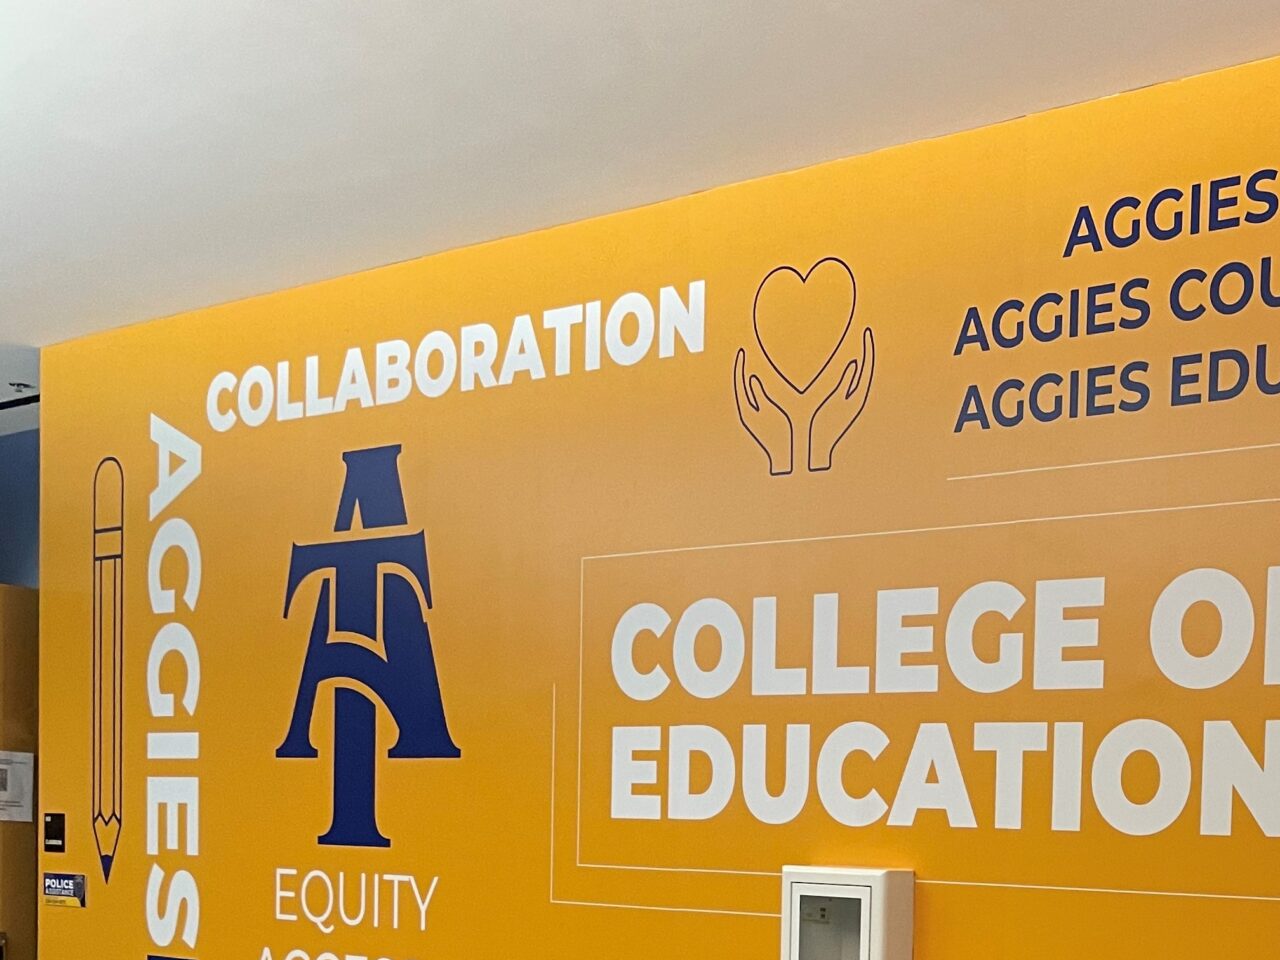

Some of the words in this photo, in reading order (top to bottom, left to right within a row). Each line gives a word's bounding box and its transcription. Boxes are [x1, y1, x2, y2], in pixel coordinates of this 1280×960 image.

[1063, 169, 1278, 257] AGGIES
[954, 278, 1150, 355] AGGIES
[205, 279, 706, 433] COLLABORATION
[954, 361, 1150, 432] AGGIES
[610, 576, 1106, 701] COLLEGE
[45, 878, 74, 889] POLICE
[276, 868, 438, 933] EQUITY
